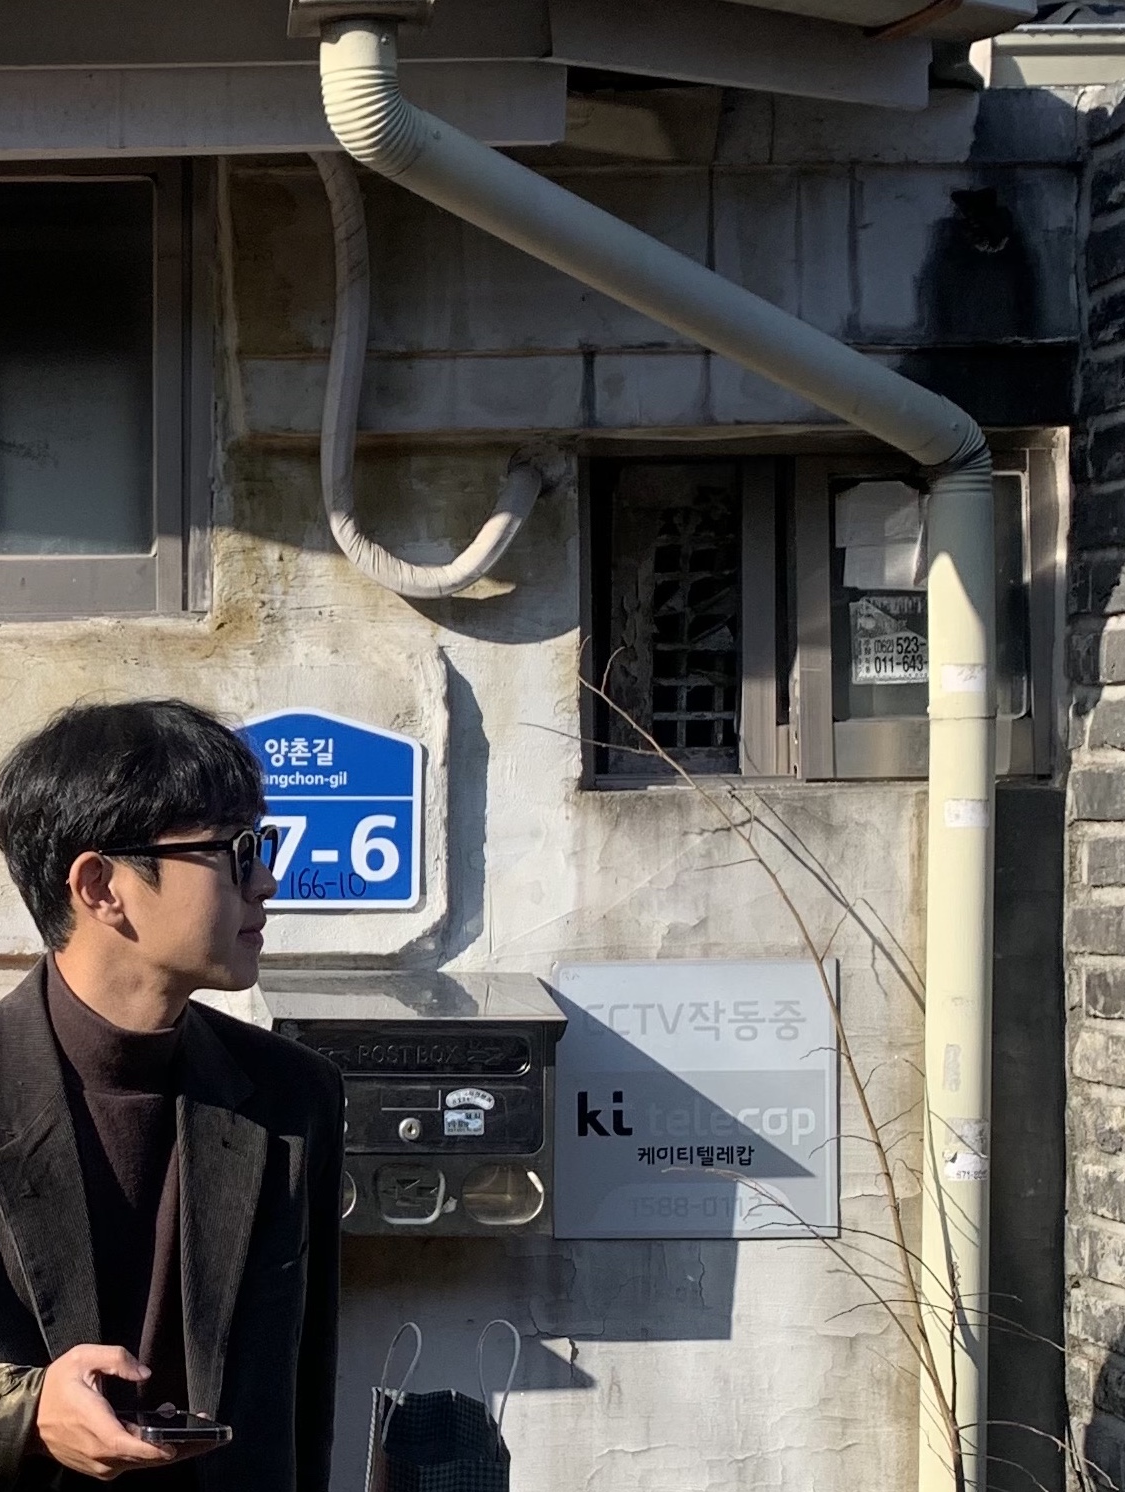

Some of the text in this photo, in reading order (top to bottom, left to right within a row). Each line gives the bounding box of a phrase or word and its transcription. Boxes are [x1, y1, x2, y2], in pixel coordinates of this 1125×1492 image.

[896, 636, 926, 654] 523-
[874, 654, 928, 674] 011-643-
[264, 737, 334, 768] 양촌길
[261, 771, 348, 788] angchon-gil
[260, 814, 400, 882] 7-6
[290, 868, 367, 899] 166-10
[648, 1097, 816, 1146] telecop
[637, 1146, 755, 1166] 케이티텔레캅
